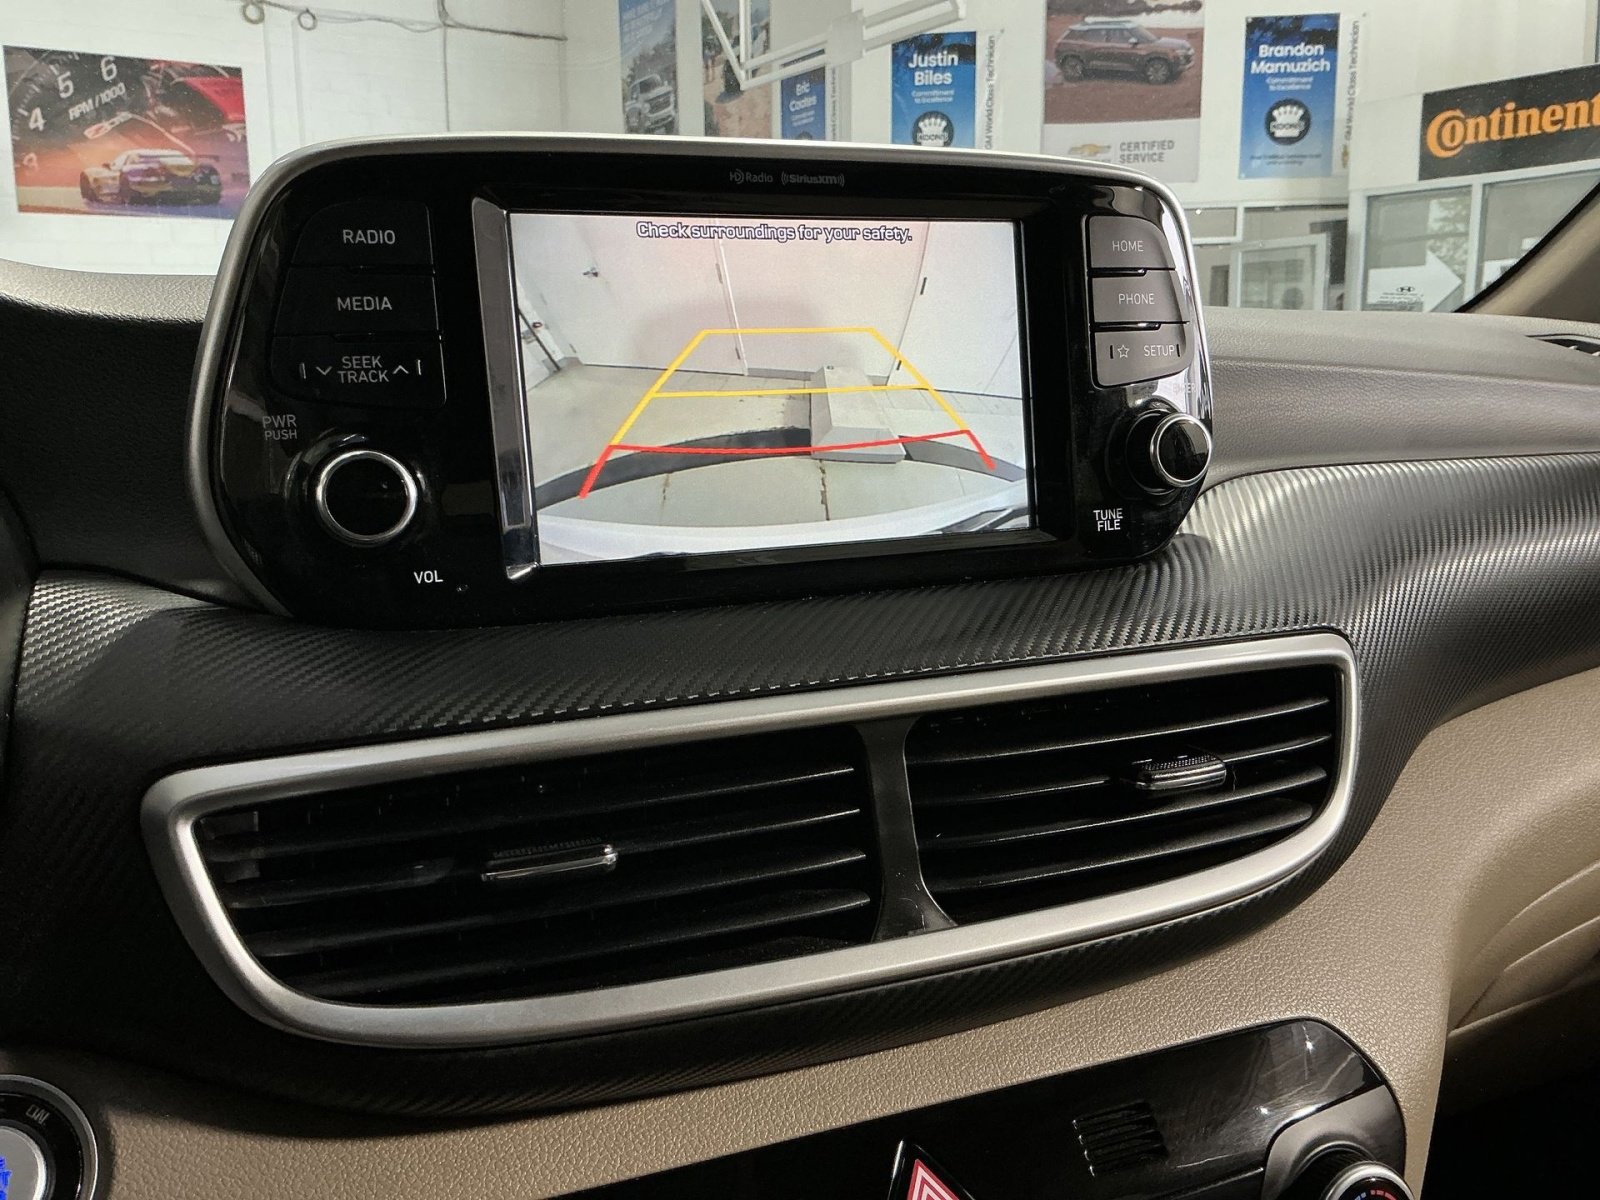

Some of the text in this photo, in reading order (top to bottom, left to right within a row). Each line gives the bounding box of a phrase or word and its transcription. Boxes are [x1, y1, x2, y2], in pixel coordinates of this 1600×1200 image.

[1258, 42, 1325, 58] Brandon
[908, 51, 959, 68] Justin
[986, 35, 996, 82] Technician
[101, 55, 118, 81] 6
[1250, 58, 1331, 74] Mamuzich
[58, 71, 74, 99] 5
[914, 71, 952, 86] Biles
[29, 107, 46, 132] 4
[1119, 140, 1175, 152] CERTIFIED
[1119, 152, 1165, 164] SERVICE
[745, 172, 774, 183] Radio
[342, 229, 396, 244] RADIO
[636, 221, 913, 244] Check surroundings for your safety.
[1112, 240, 1144, 252] HOME
[337, 296, 393, 311] MEDIA
[1118, 293, 1155, 305] PHONE
[1143, 345, 1175, 357] SETUP
[341, 355, 383, 369] SEEK
[337, 370, 390, 384] TRACK
[262, 414, 297, 429] PWR
[264, 429, 298, 441] PUSH
[1092, 507, 1124, 521] TUNE
[1097, 518, 1121, 532] FILE
[413, 570, 444, 584] VOL
